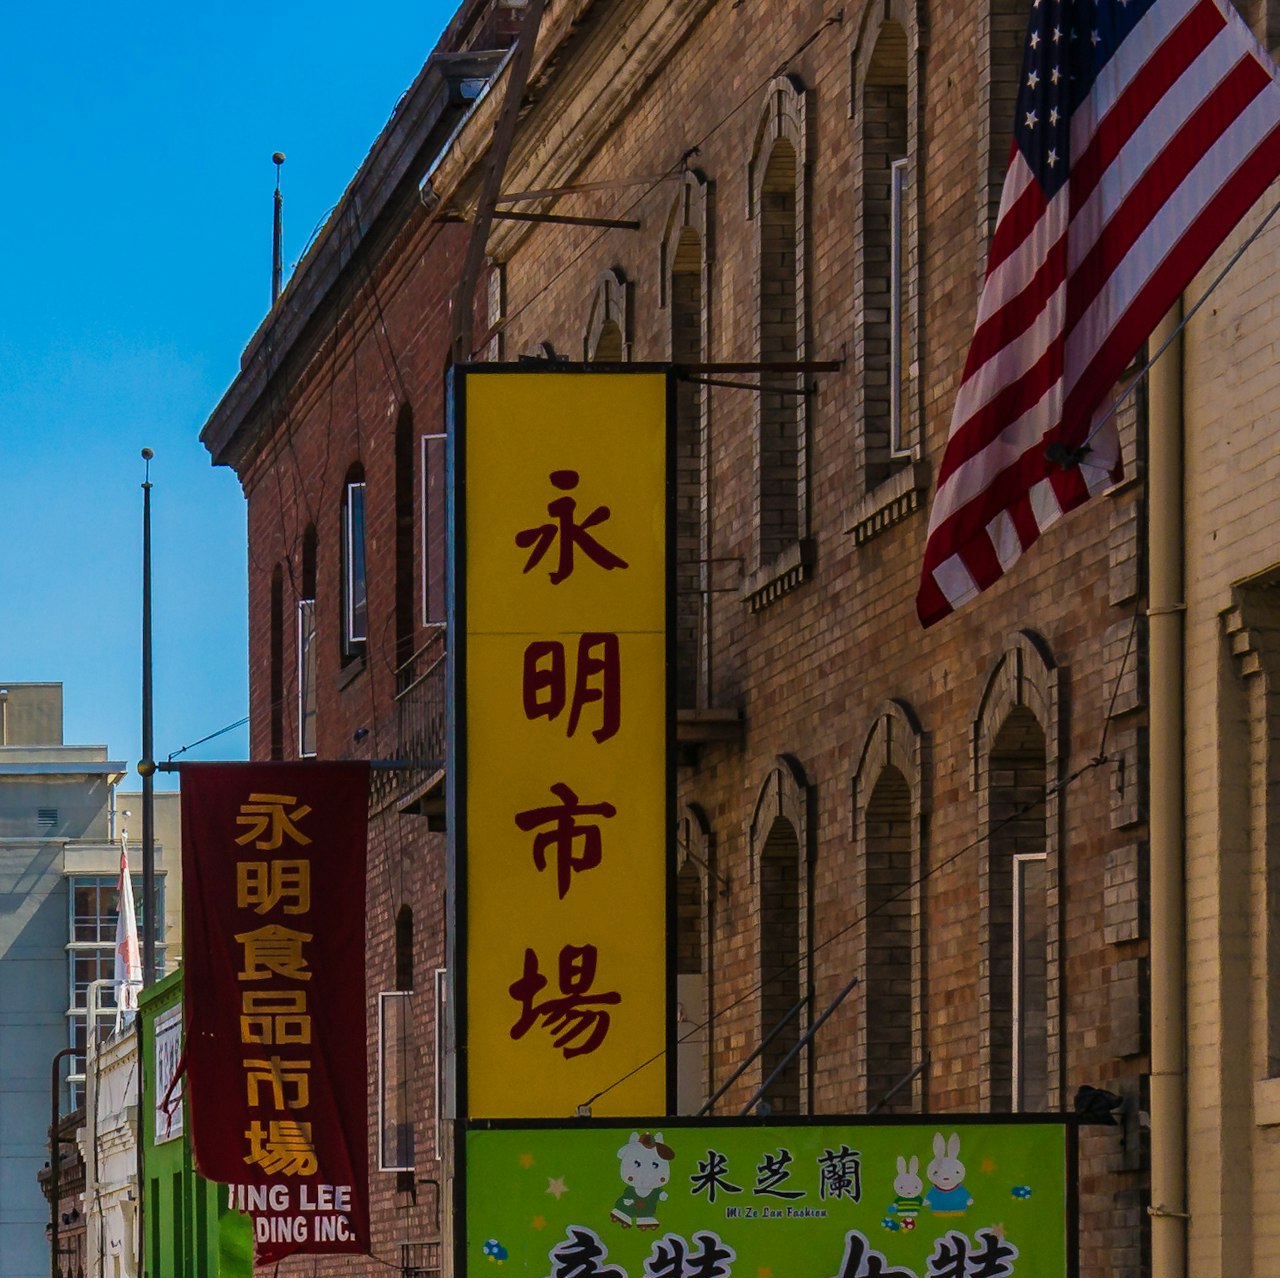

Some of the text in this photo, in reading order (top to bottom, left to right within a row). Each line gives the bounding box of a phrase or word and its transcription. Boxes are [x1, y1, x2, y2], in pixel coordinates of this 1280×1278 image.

[508, 470, 629, 1060] 永明市場
[235, 793, 318, 1176] 永明食品市場
[690, 1146, 864, 1204] 米芝蘭
[228, 1184, 352, 1211] ING LEE
[786, 1206, 829, 1220] Fashion
[314, 1215, 355, 1242] INC.
